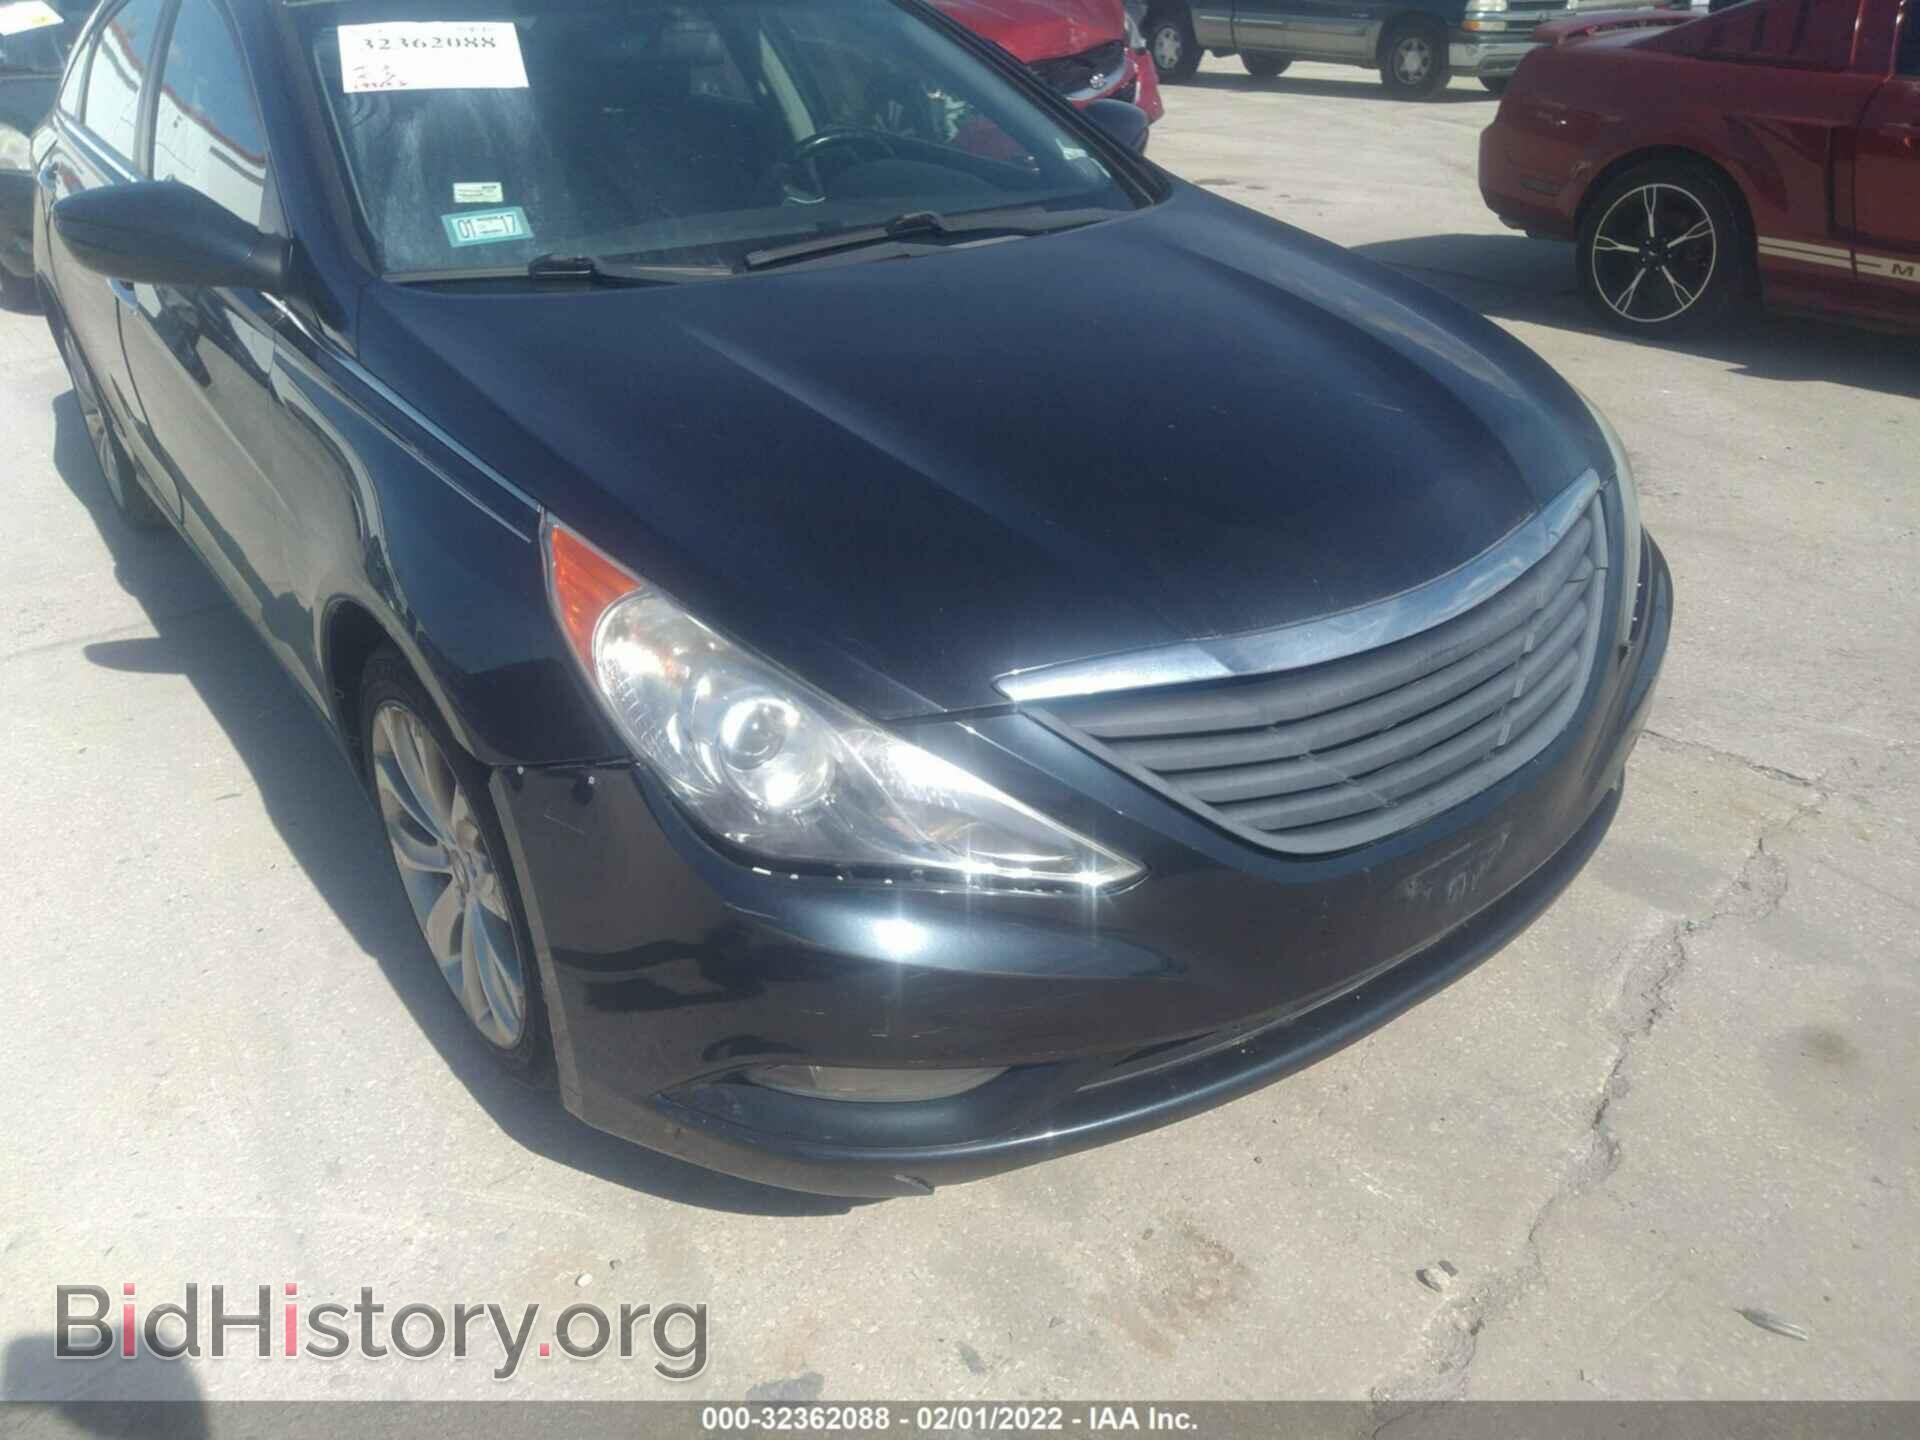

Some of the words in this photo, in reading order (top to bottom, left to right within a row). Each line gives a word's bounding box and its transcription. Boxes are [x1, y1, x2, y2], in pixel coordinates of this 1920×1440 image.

[362, 36, 497, 50] 32362088
[457, 218, 477, 239] 01
[500, 214, 516, 233] 17
